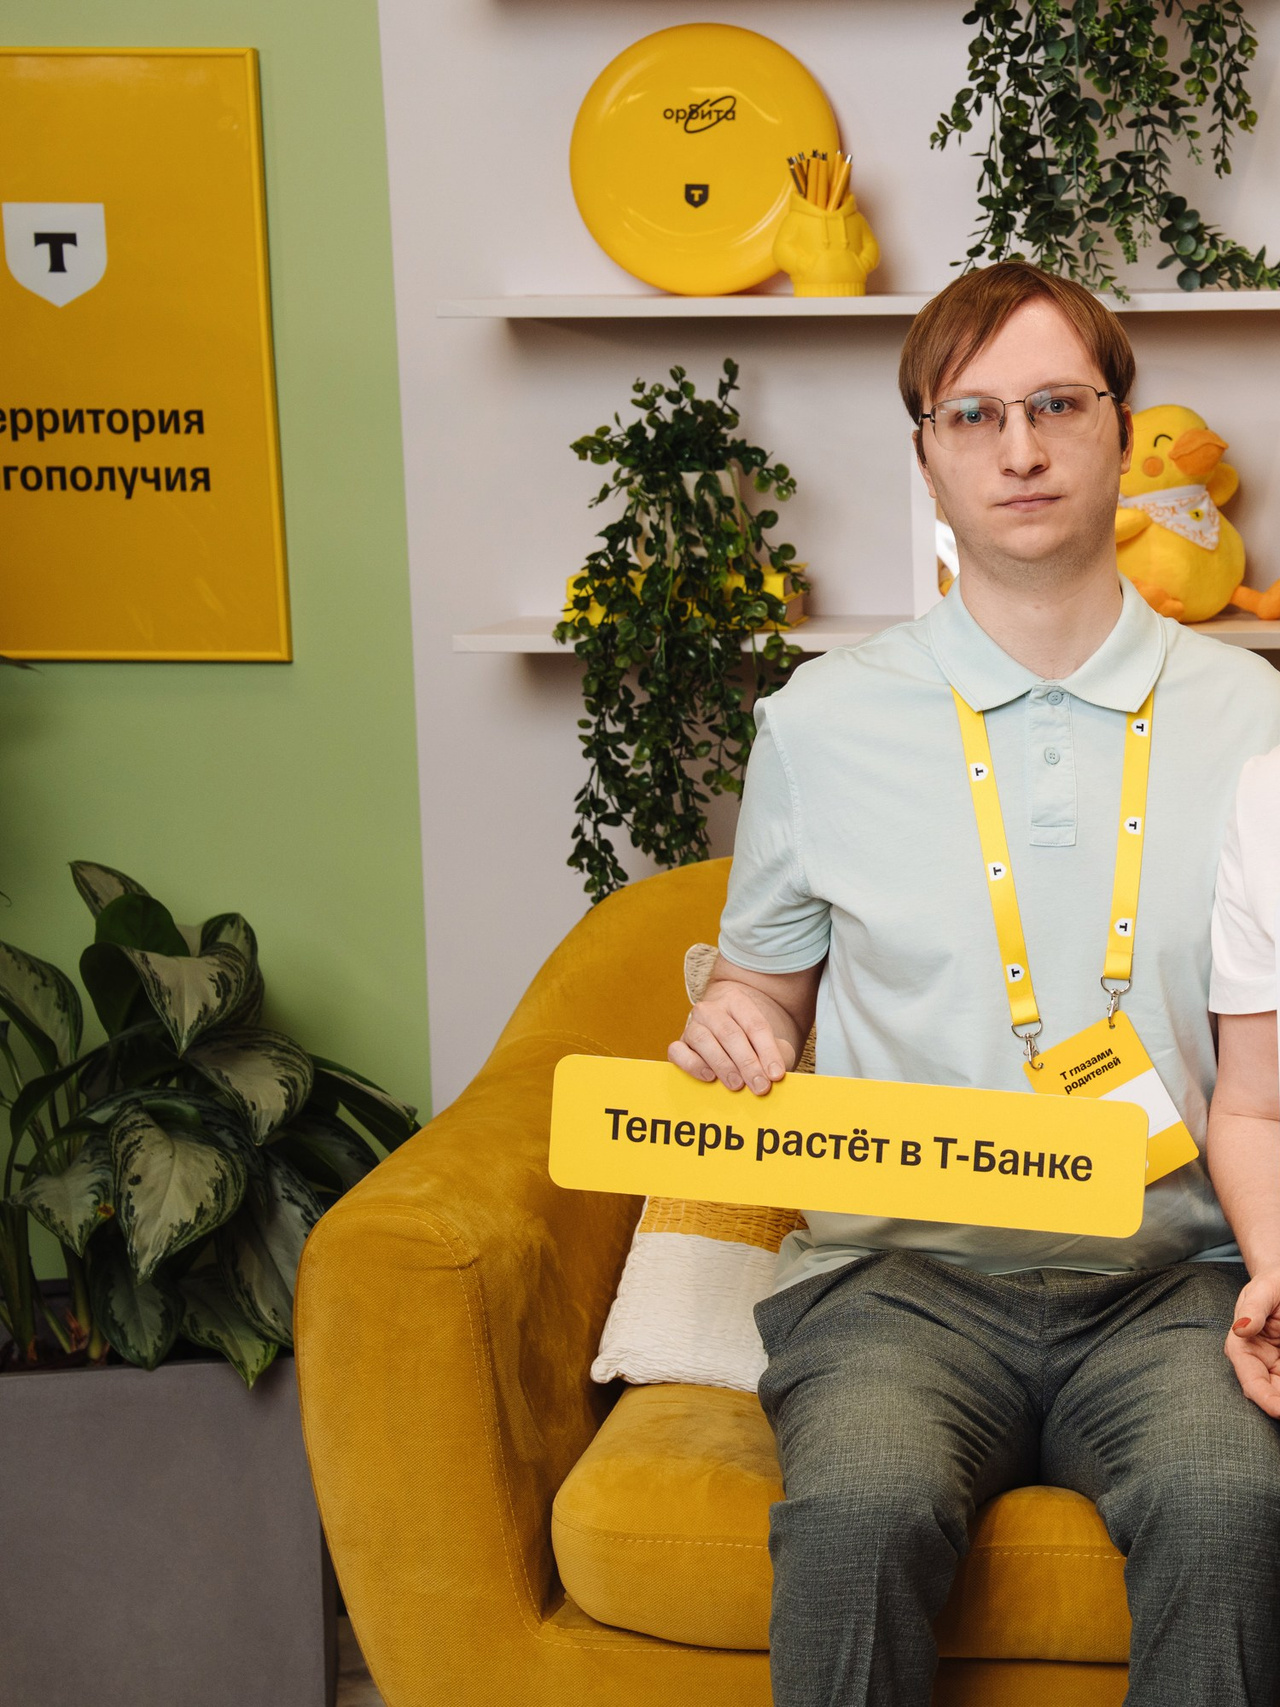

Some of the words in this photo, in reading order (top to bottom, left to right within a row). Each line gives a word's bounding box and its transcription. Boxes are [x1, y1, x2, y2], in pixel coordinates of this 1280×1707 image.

[33, 232, 78, 273] Т
[1060, 1071, 1068, 1080] Т
[1069, 1048, 1114, 1076] глазами
[1064, 1056, 1122, 1095] родителей
[604, 1107, 745, 1157] Теперь
[755, 1127, 891, 1163] растёт
[900, 1140, 922, 1167] в
[933, 1136, 1093, 1182] Т-Банке
